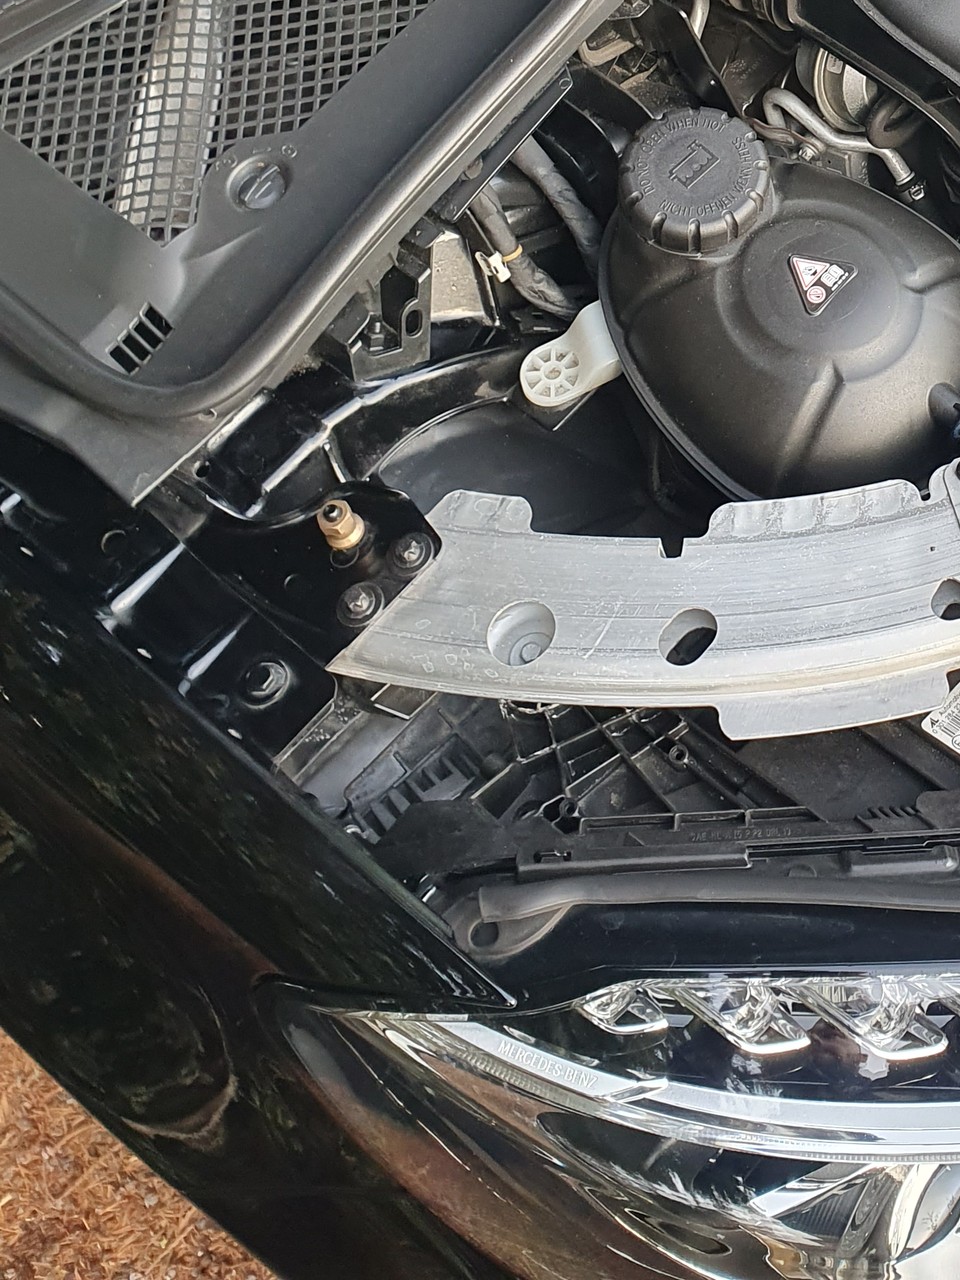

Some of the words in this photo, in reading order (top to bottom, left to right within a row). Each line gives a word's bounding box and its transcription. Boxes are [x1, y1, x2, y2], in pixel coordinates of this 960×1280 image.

[665, 118, 700, 133] WHEN
[636, 156, 650, 178] NOT
[640, 179, 656, 196] DO
[659, 199, 693, 217] NICHT
[497, 1040, 599, 1089] MERCEDES-BENZ
